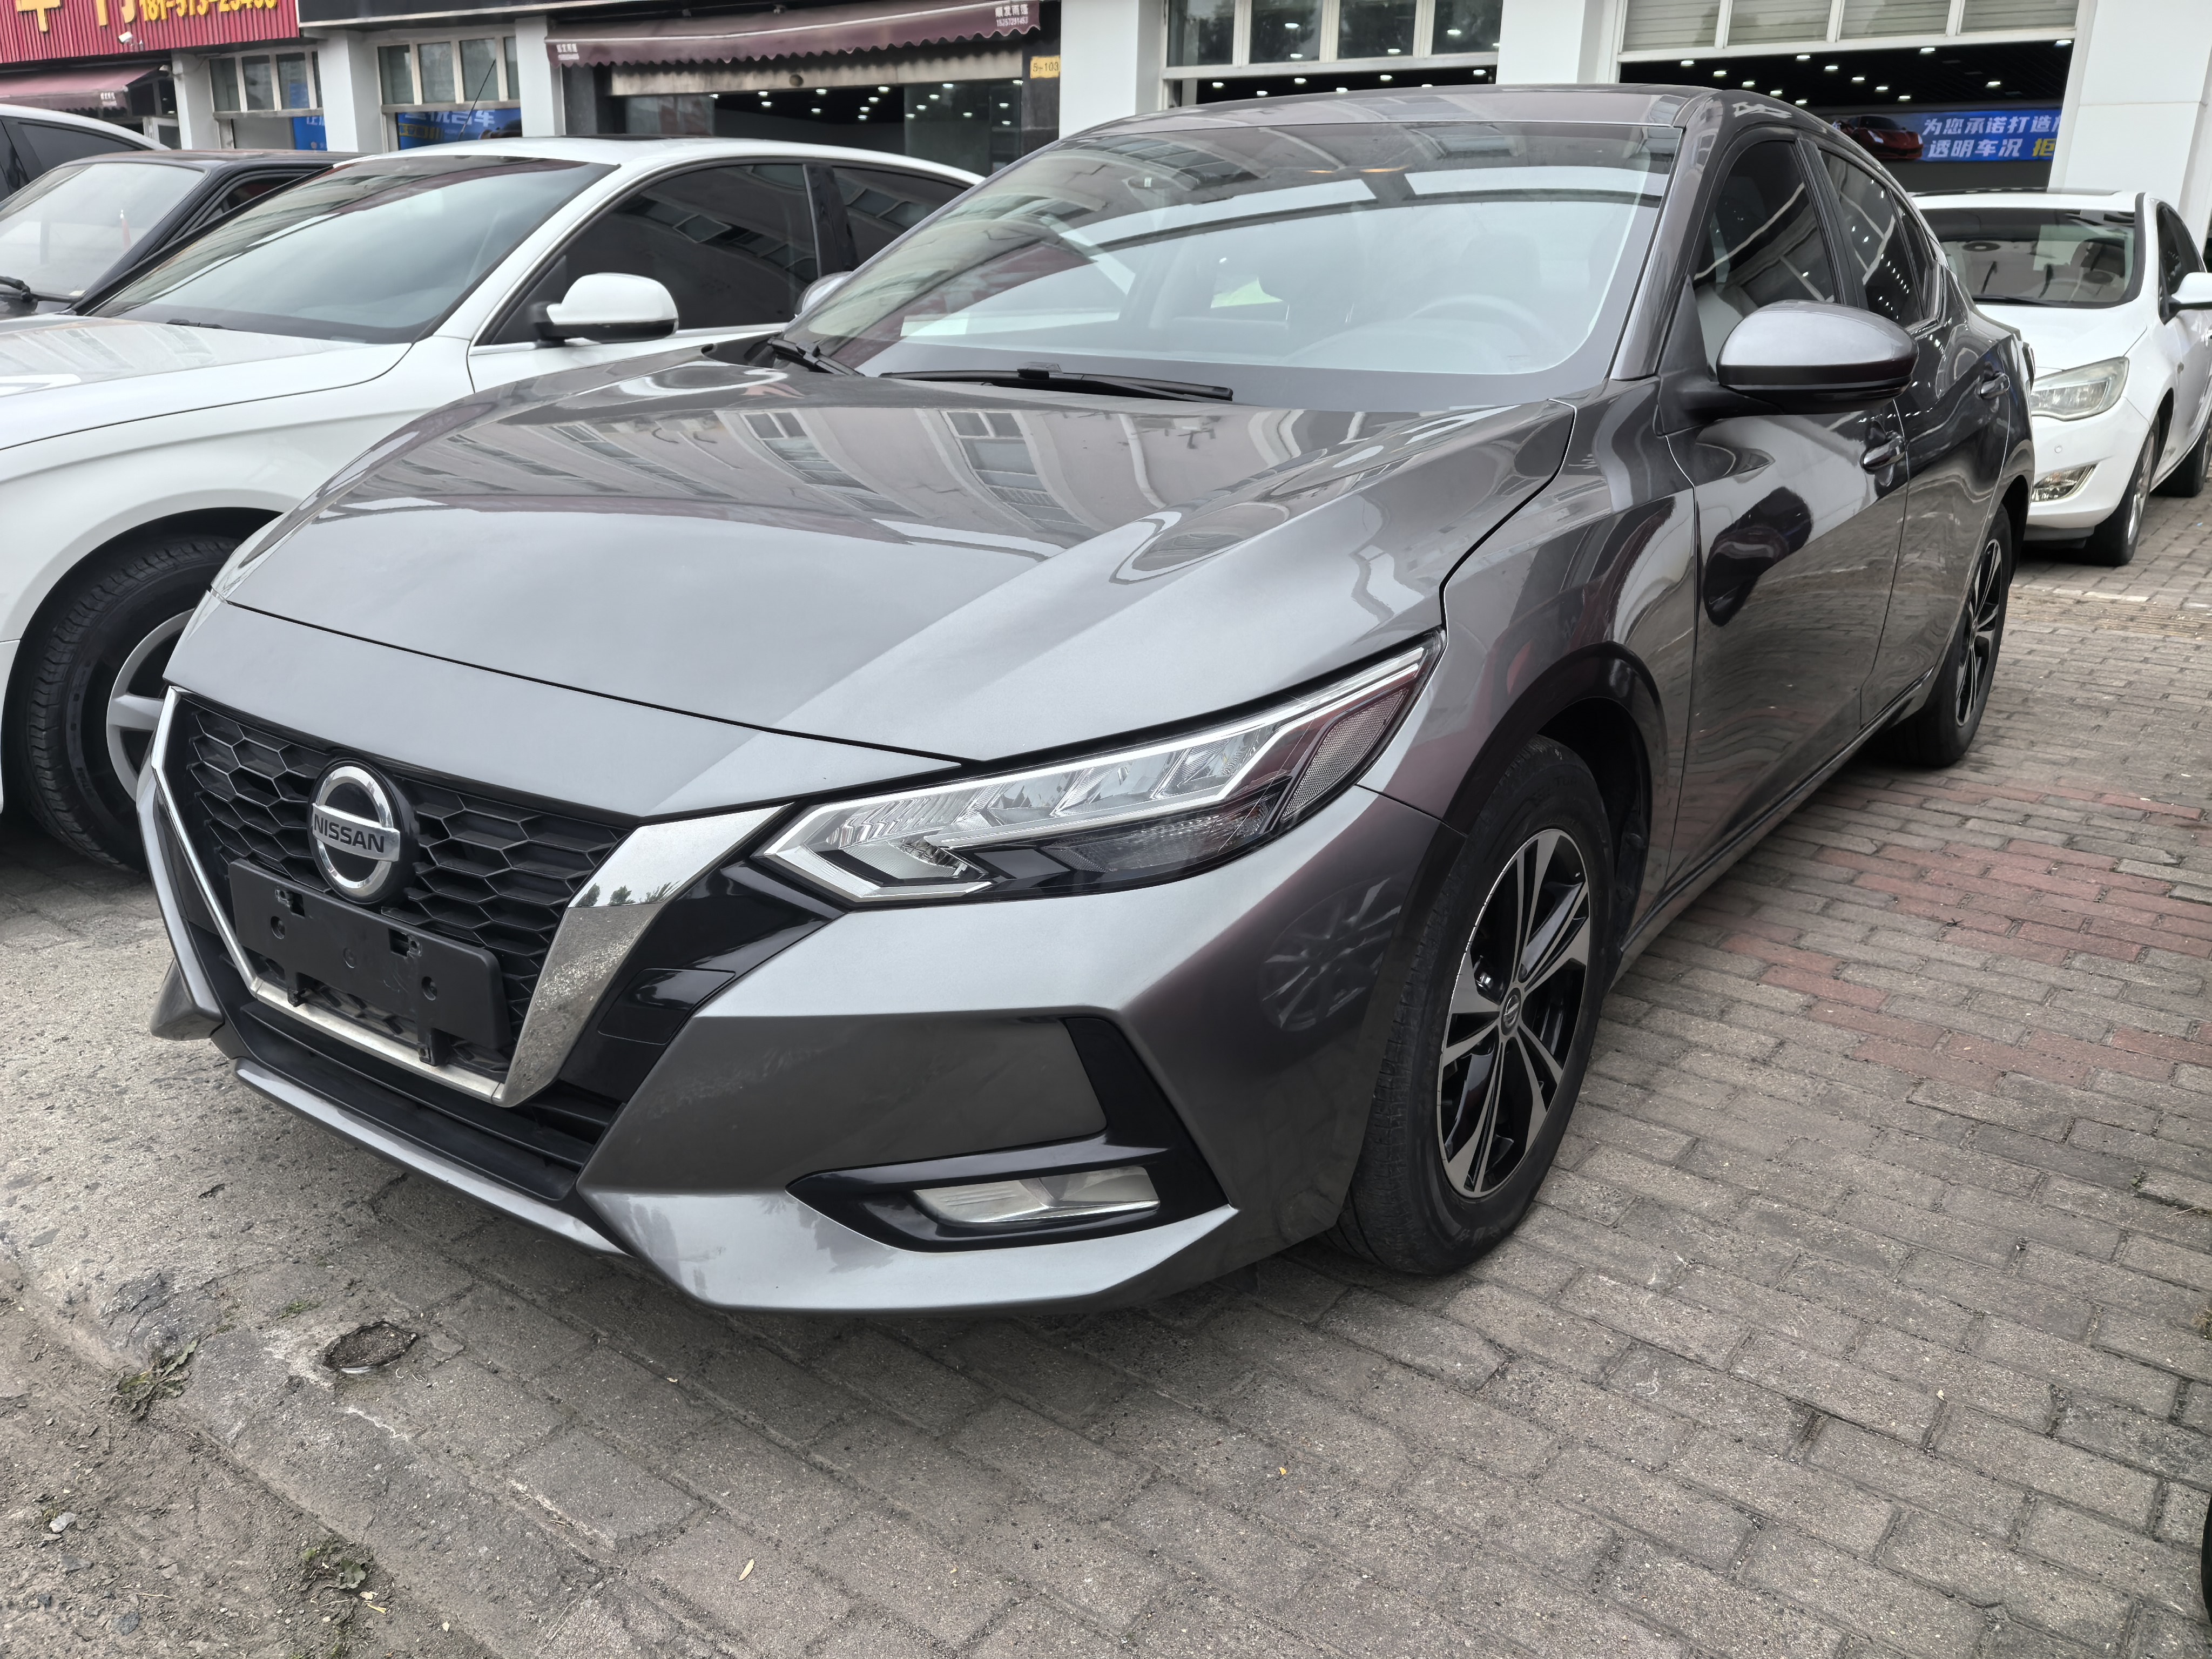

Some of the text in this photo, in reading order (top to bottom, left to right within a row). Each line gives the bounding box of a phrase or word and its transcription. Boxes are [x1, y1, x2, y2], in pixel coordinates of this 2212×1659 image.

[1033, 62, 1059, 72] 5-103
[1927, 138, 2023, 158] 透明车况
[314, 813, 385, 853] NISSAN
